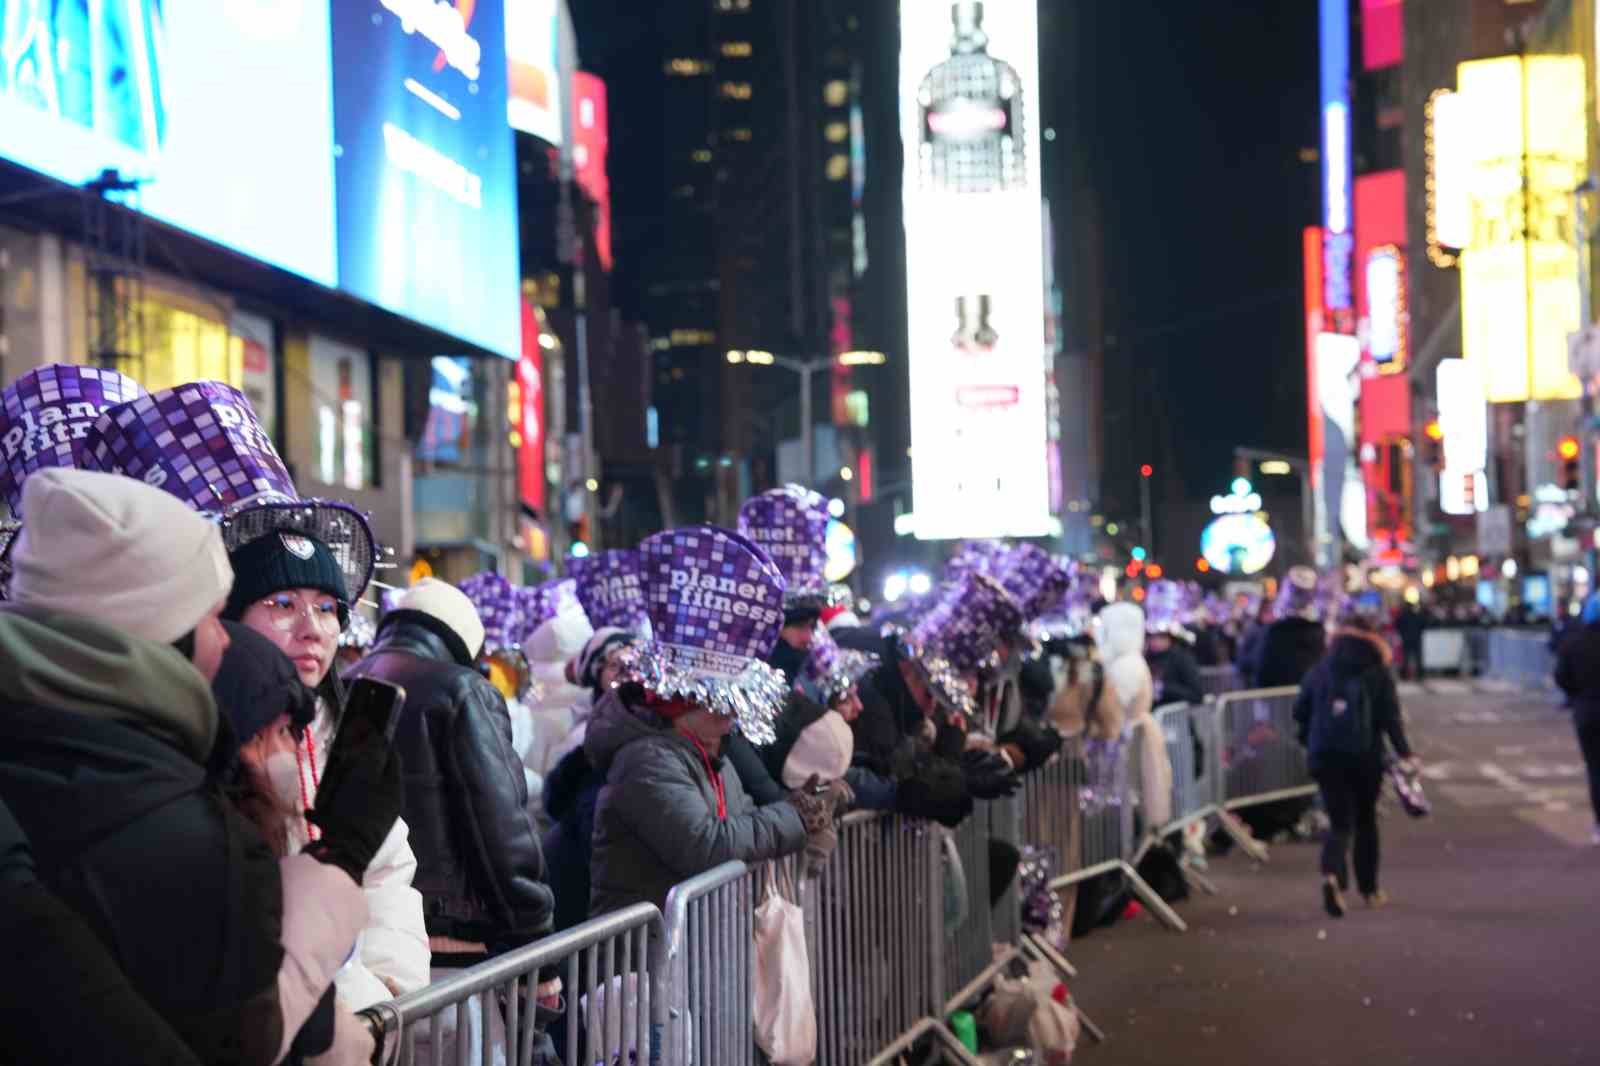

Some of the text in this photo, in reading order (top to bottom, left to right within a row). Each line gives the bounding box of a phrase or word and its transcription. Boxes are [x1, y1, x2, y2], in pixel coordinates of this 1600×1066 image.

[2, 402, 111, 460] plan
[670, 567, 768, 602] planet
[680, 585, 778, 624] fitness
